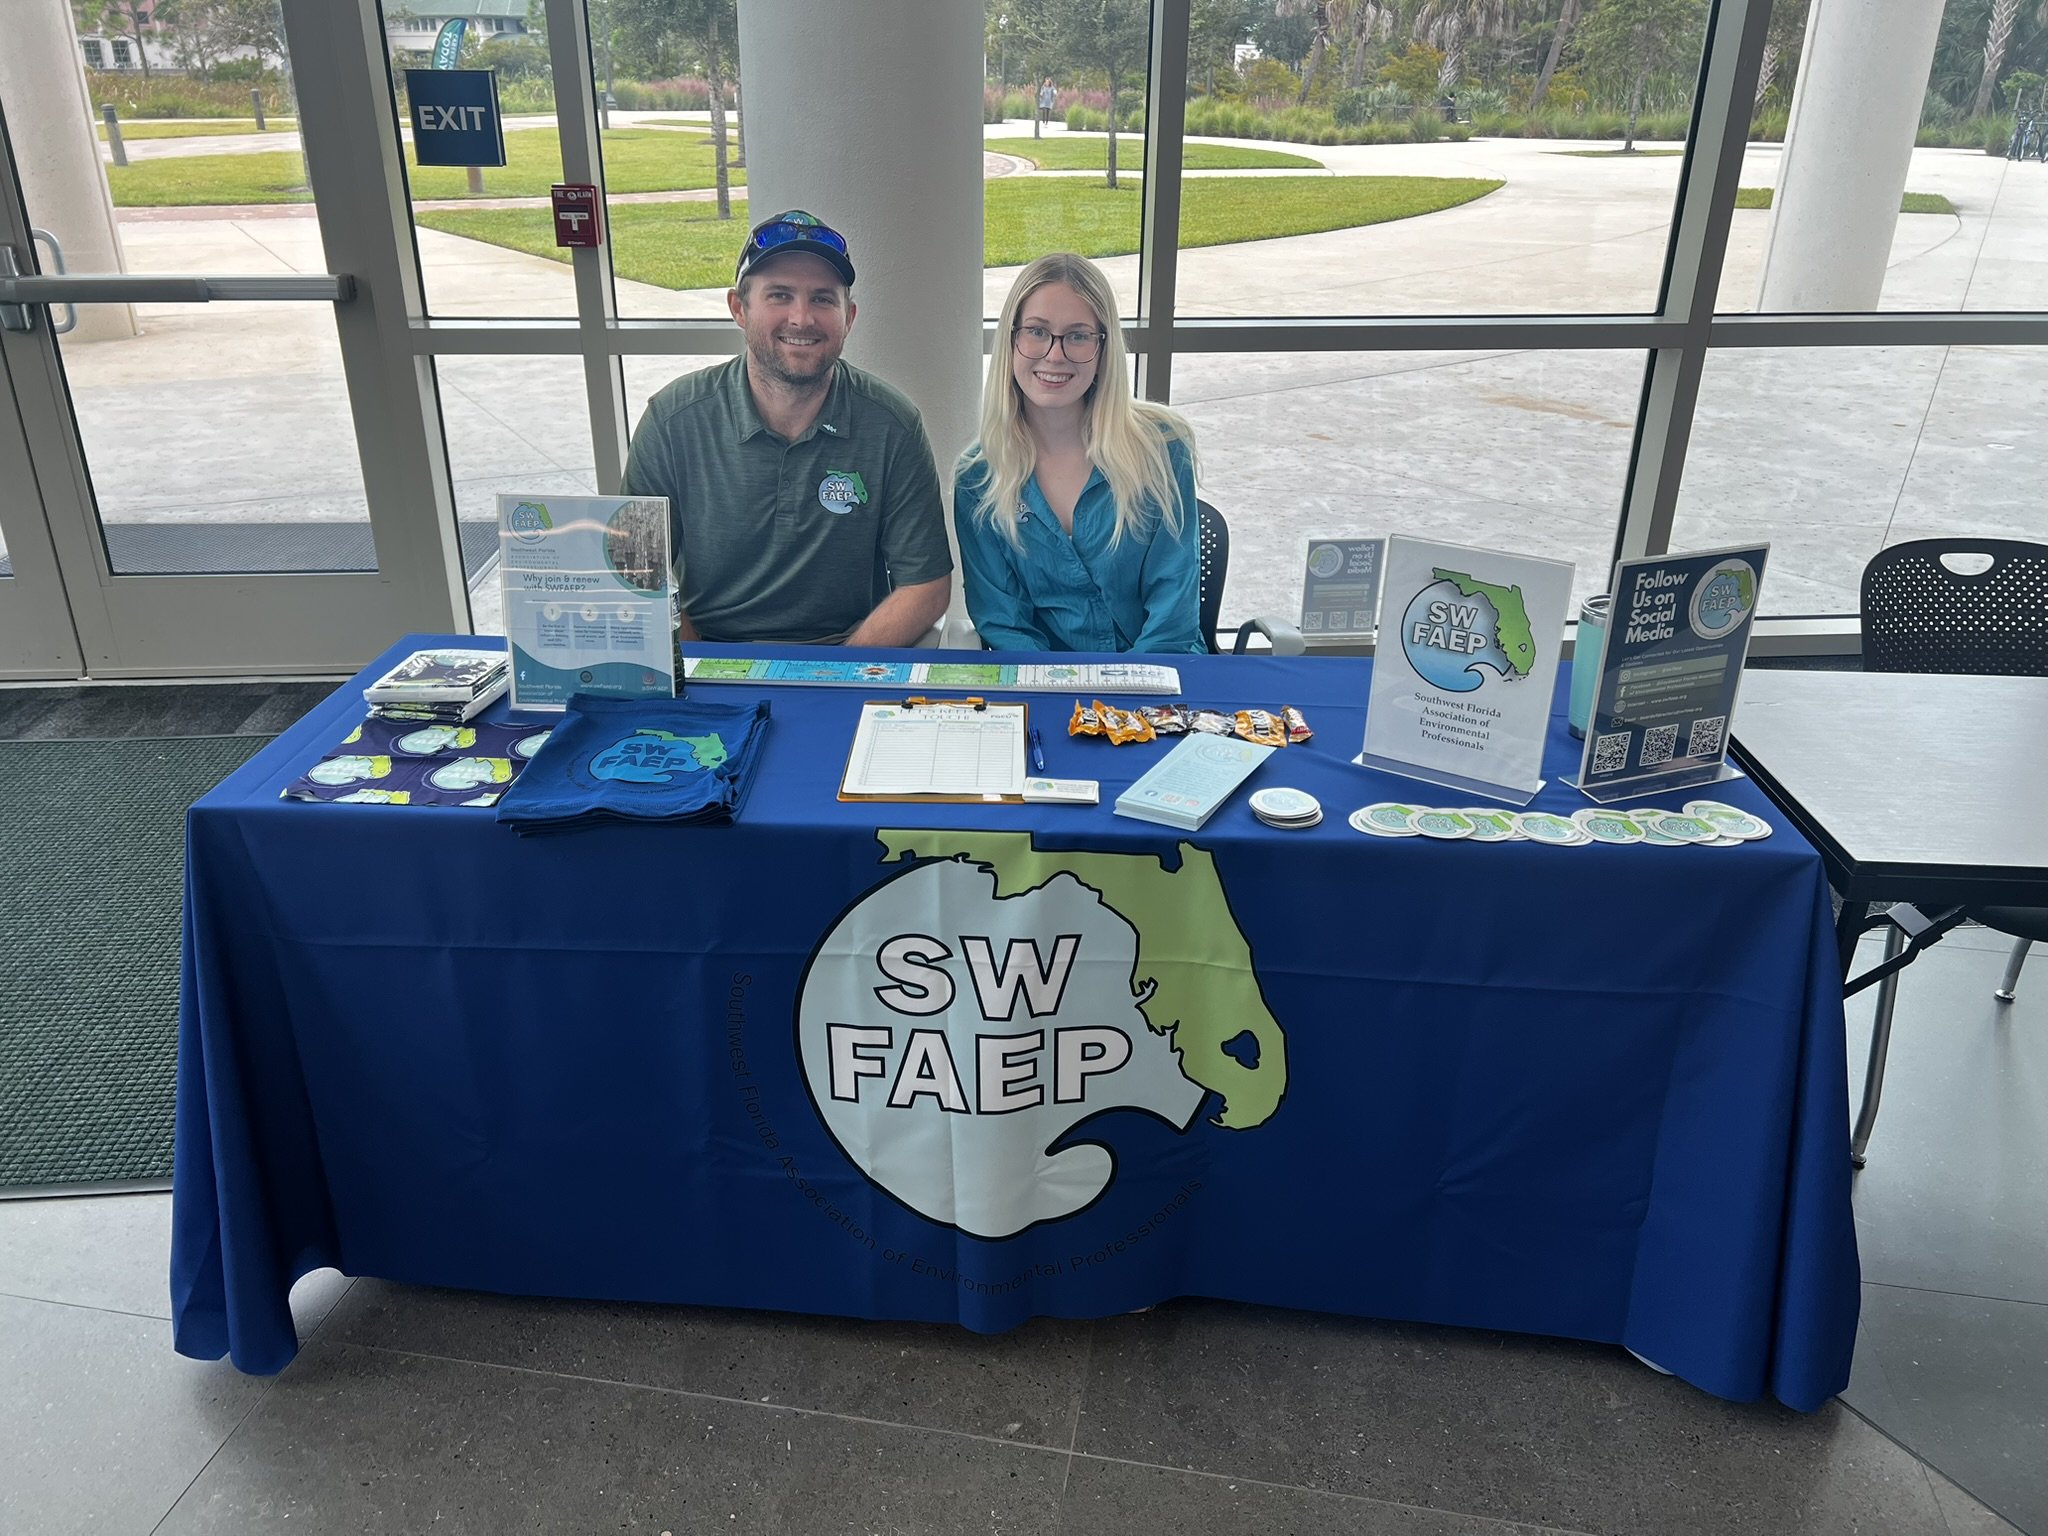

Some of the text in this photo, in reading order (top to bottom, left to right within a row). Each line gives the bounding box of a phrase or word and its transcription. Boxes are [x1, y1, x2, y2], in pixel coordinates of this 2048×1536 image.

[439, 31, 453, 70] TODAY
[418, 105, 486, 131] EXIT
[822, 491, 852, 501] FAEP
[828, 481, 846, 491] SW
[514, 520, 540, 528] FAEP
[519, 511, 535, 519] SW
[523, 574, 600, 584] Why join & renew
[1635, 570, 1689, 591] Follow
[1632, 591, 1675, 608] Us on
[1710, 584, 1733, 598] SW
[587, 609, 593, 617] 2
[1428, 600, 1478, 629] SW
[1628, 603, 1677, 627] Social
[1701, 597, 1736, 612] FAEP
[1412, 621, 1488, 656] FAEP
[1624, 625, 1675, 645] Media
[1414, 691, 1502, 718] Southwest Florida
[1422, 706, 1491, 728] Association of
[1419, 717, 1490, 740] Environmental
[620, 743, 677, 756] SW
[1421, 729, 1485, 751] Professionals
[598, 754, 687, 769] FAEP
[873, 933, 1082, 1021] SW
[826, 1022, 1133, 1115] FAEP
[727, 972, 1204, 1297] Southwest Florida Association of Environmental Professionals
